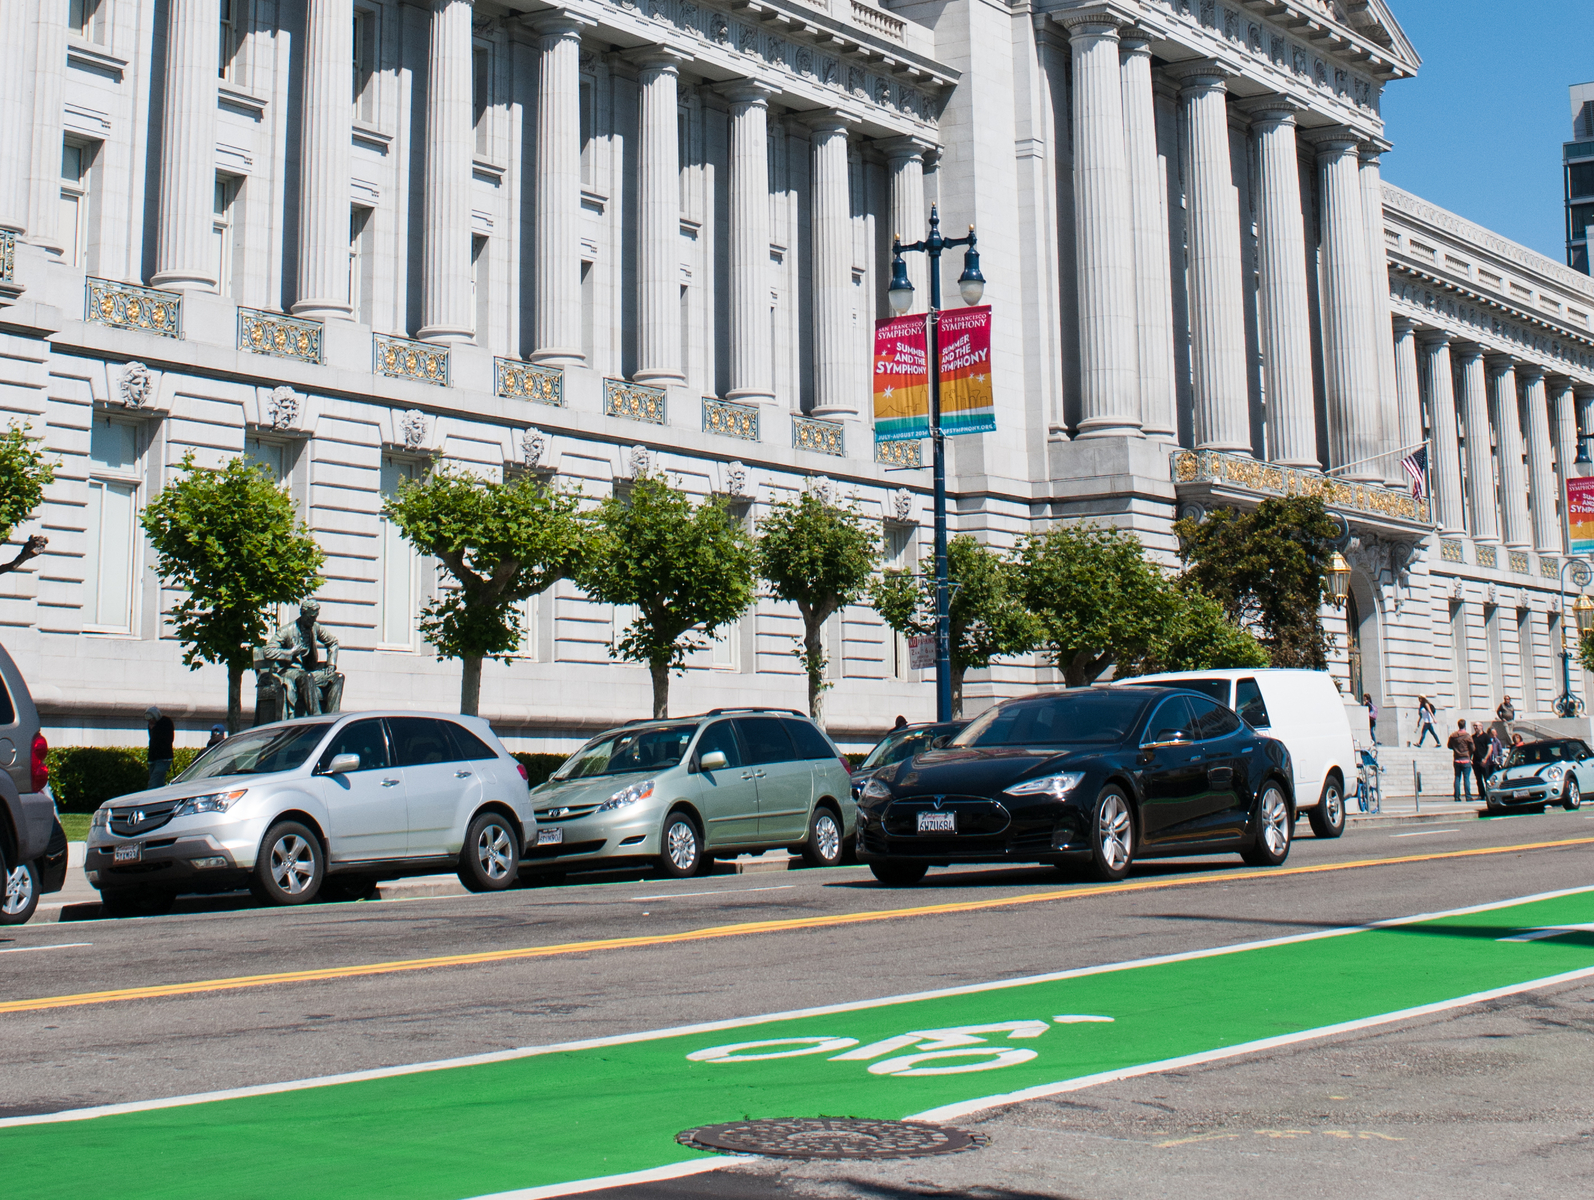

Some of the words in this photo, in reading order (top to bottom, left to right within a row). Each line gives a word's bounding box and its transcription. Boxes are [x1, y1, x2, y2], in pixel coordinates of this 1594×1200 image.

[954, 314, 987, 322] FRANCISCO
[891, 321, 923, 330] FRANCISCO
[941, 319, 987, 332] SYMPHONY
[877, 327, 922, 340] SYMPHONY
[896, 342, 926, 358] SUMMER
[942, 334, 970, 356] SUMMER
[894, 352, 914, 364] AND
[914, 356, 926, 366] THE
[941, 352, 955, 364] AND
[955, 343, 971, 358] THE
[941, 347, 988, 373] SYMPHONY
[876, 361, 926, 374] SYMPHONY
